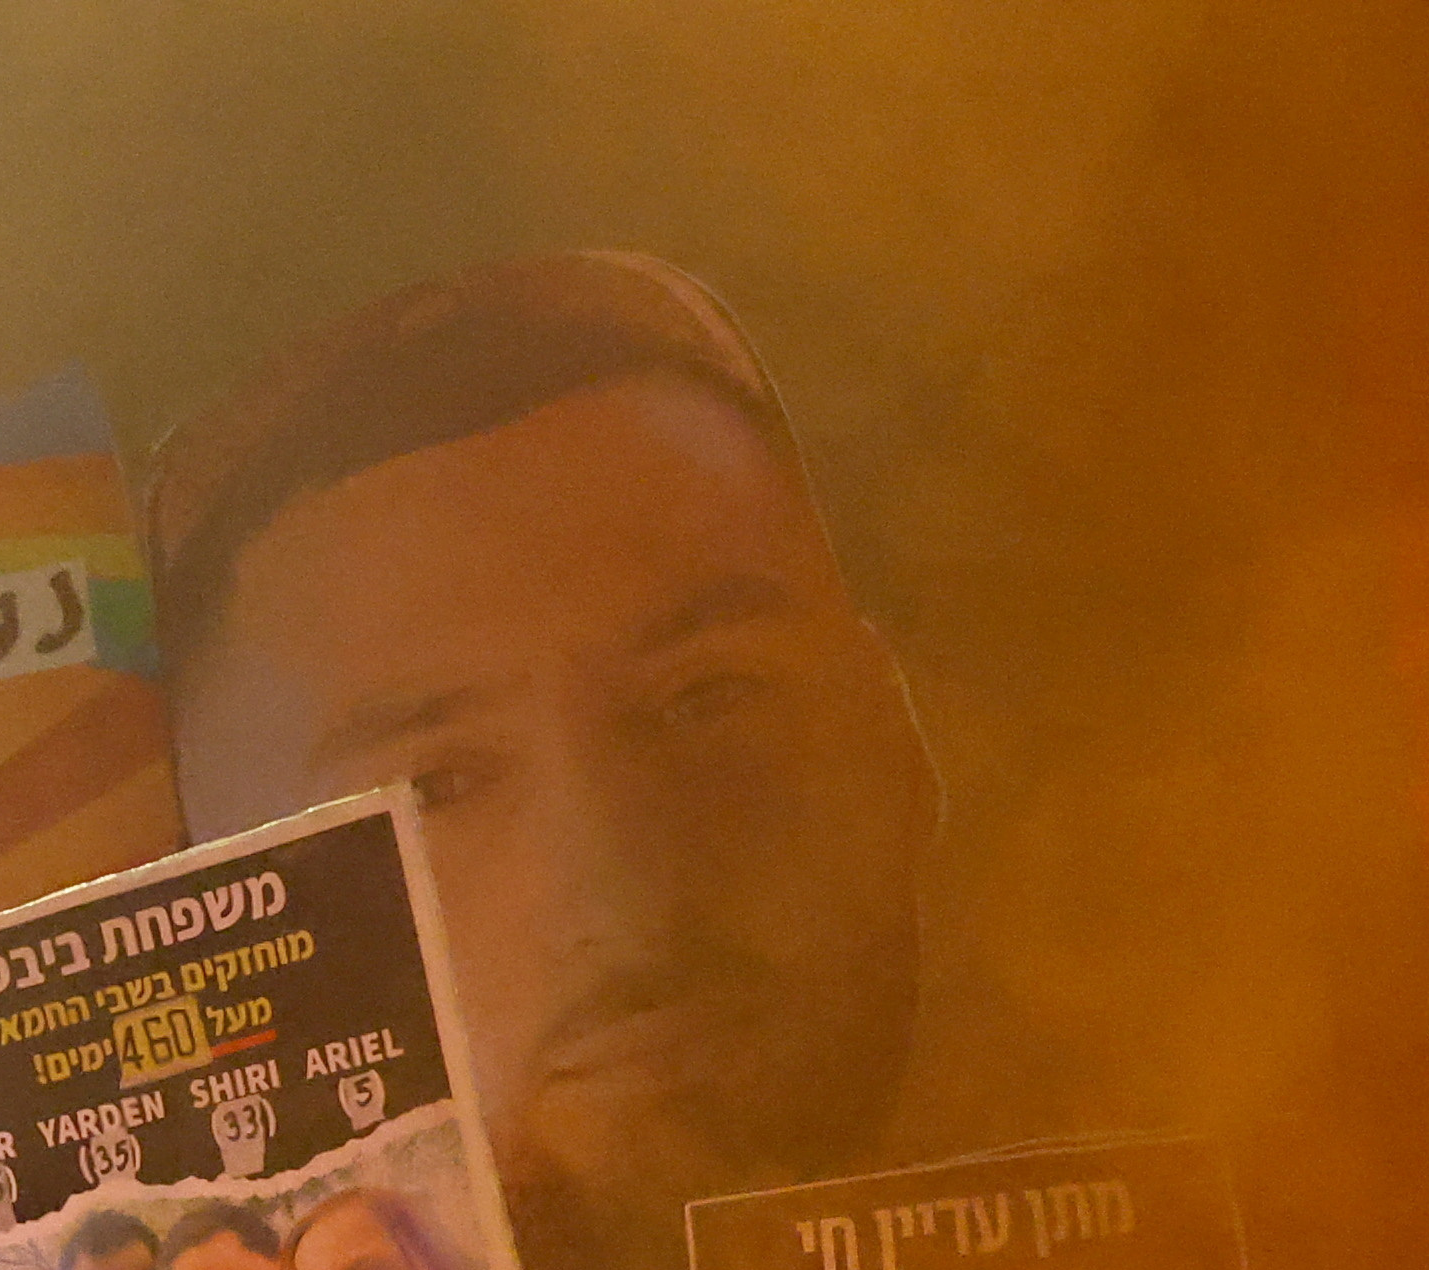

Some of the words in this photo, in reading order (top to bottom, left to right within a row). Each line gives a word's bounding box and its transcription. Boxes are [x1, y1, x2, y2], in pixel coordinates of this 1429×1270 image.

[100, 871, 286, 964] משפחת
[95, 971, 176, 1013] בשבי
[180, 929, 315, 992] מוחזקים
[118, 1006, 198, 1071] 460
[206, 996, 273, 1037] מעל
[32, 1038, 114, 1084] ימים!
[37, 1091, 166, 1149] YARDEN
[190, 1059, 282, 1108] SHIRI
[306, 1028, 406, 1079] ARIEL
[1026, 1179, 1137, 1259] מתן
